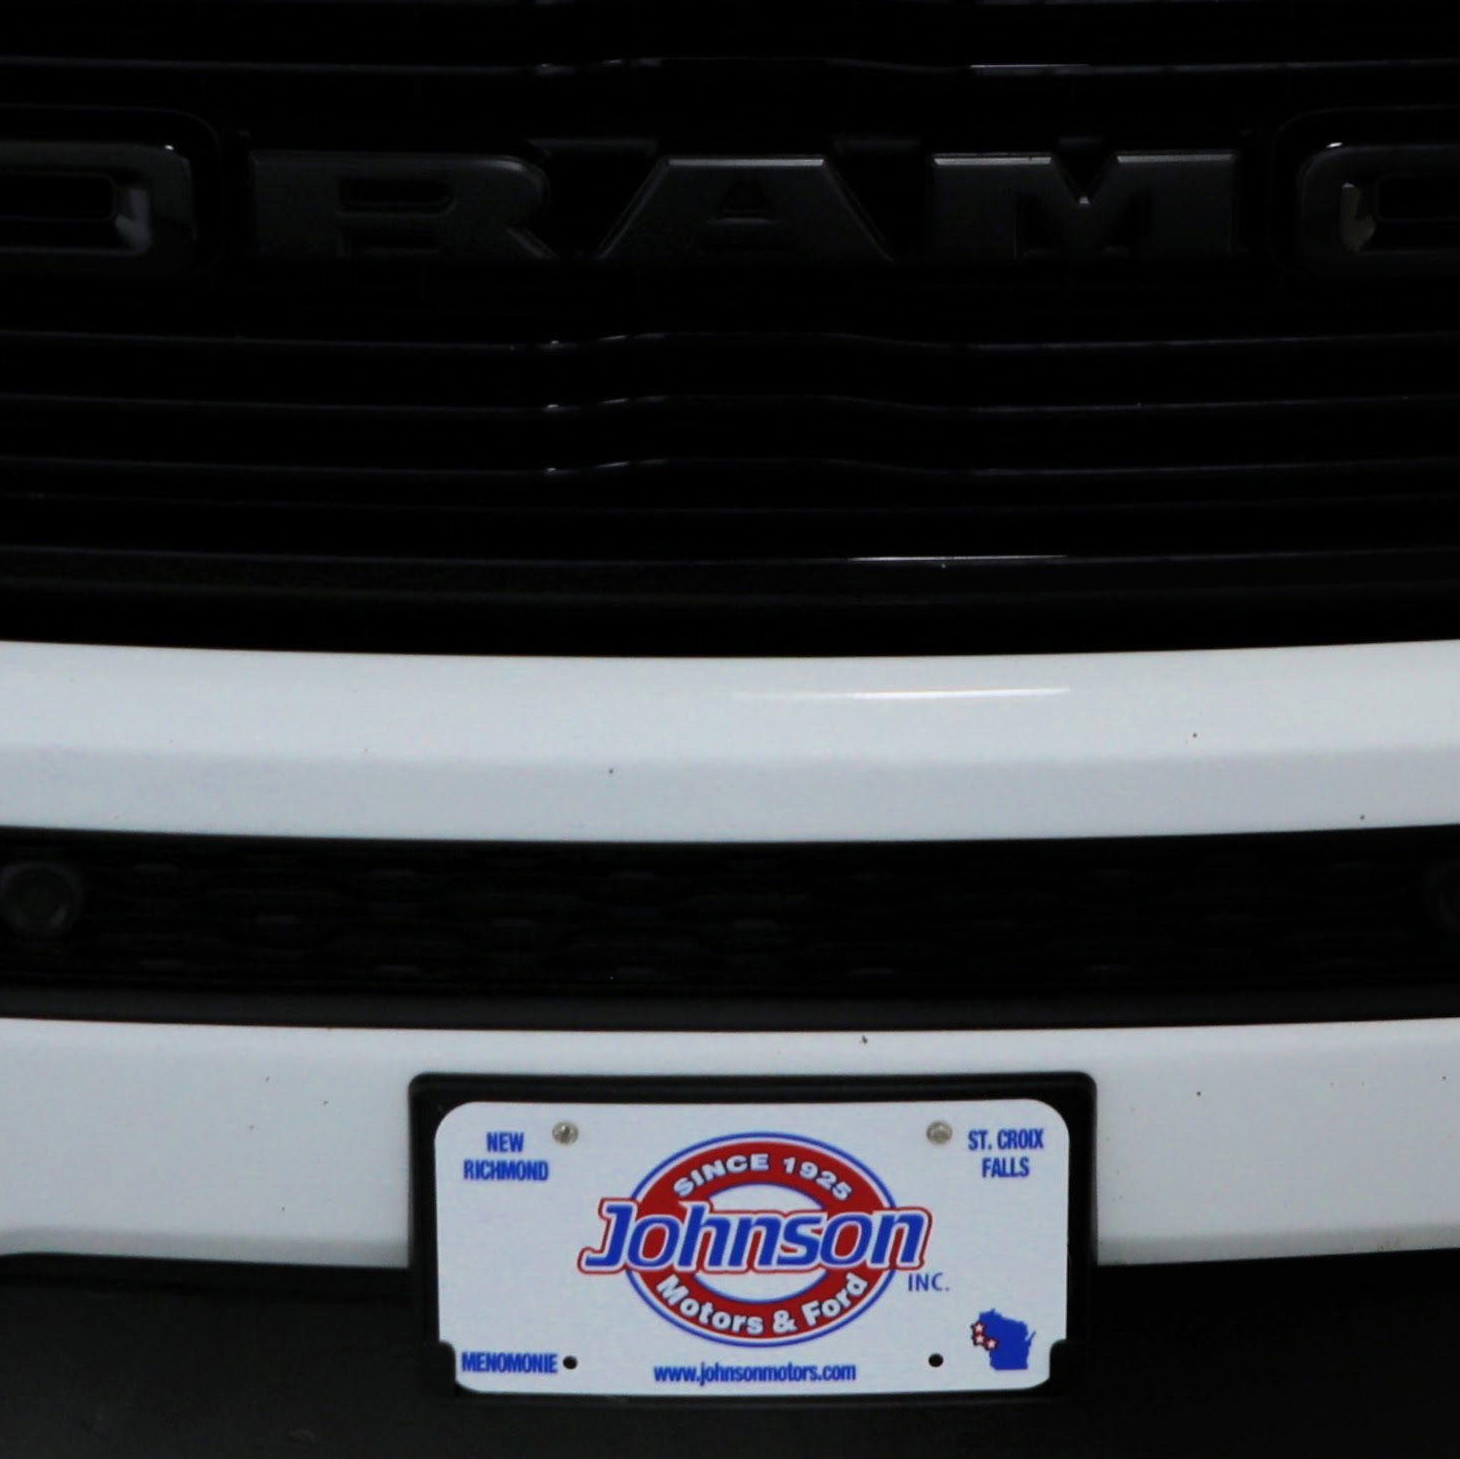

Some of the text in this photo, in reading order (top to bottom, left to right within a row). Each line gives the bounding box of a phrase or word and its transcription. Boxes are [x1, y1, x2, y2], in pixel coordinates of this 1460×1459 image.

[247, 150, 1241, 265] RAM
[486, 1132, 524, 1153] NEW
[968, 1128, 1044, 1150] ST. CROIX
[463, 1159, 549, 1181] RICHMOND
[673, 1153, 852, 1201] SINCE 1925
[982, 1157, 1030, 1178] FALLS
[584, 1203, 927, 1268] Johnson
[908, 1273, 950, 1292] INC.
[656, 1272, 869, 1335] Motors & Ford
[462, 1352, 558, 1373] MENOMONIE
[653, 1362, 856, 1386] www.johnsonmotors.com
